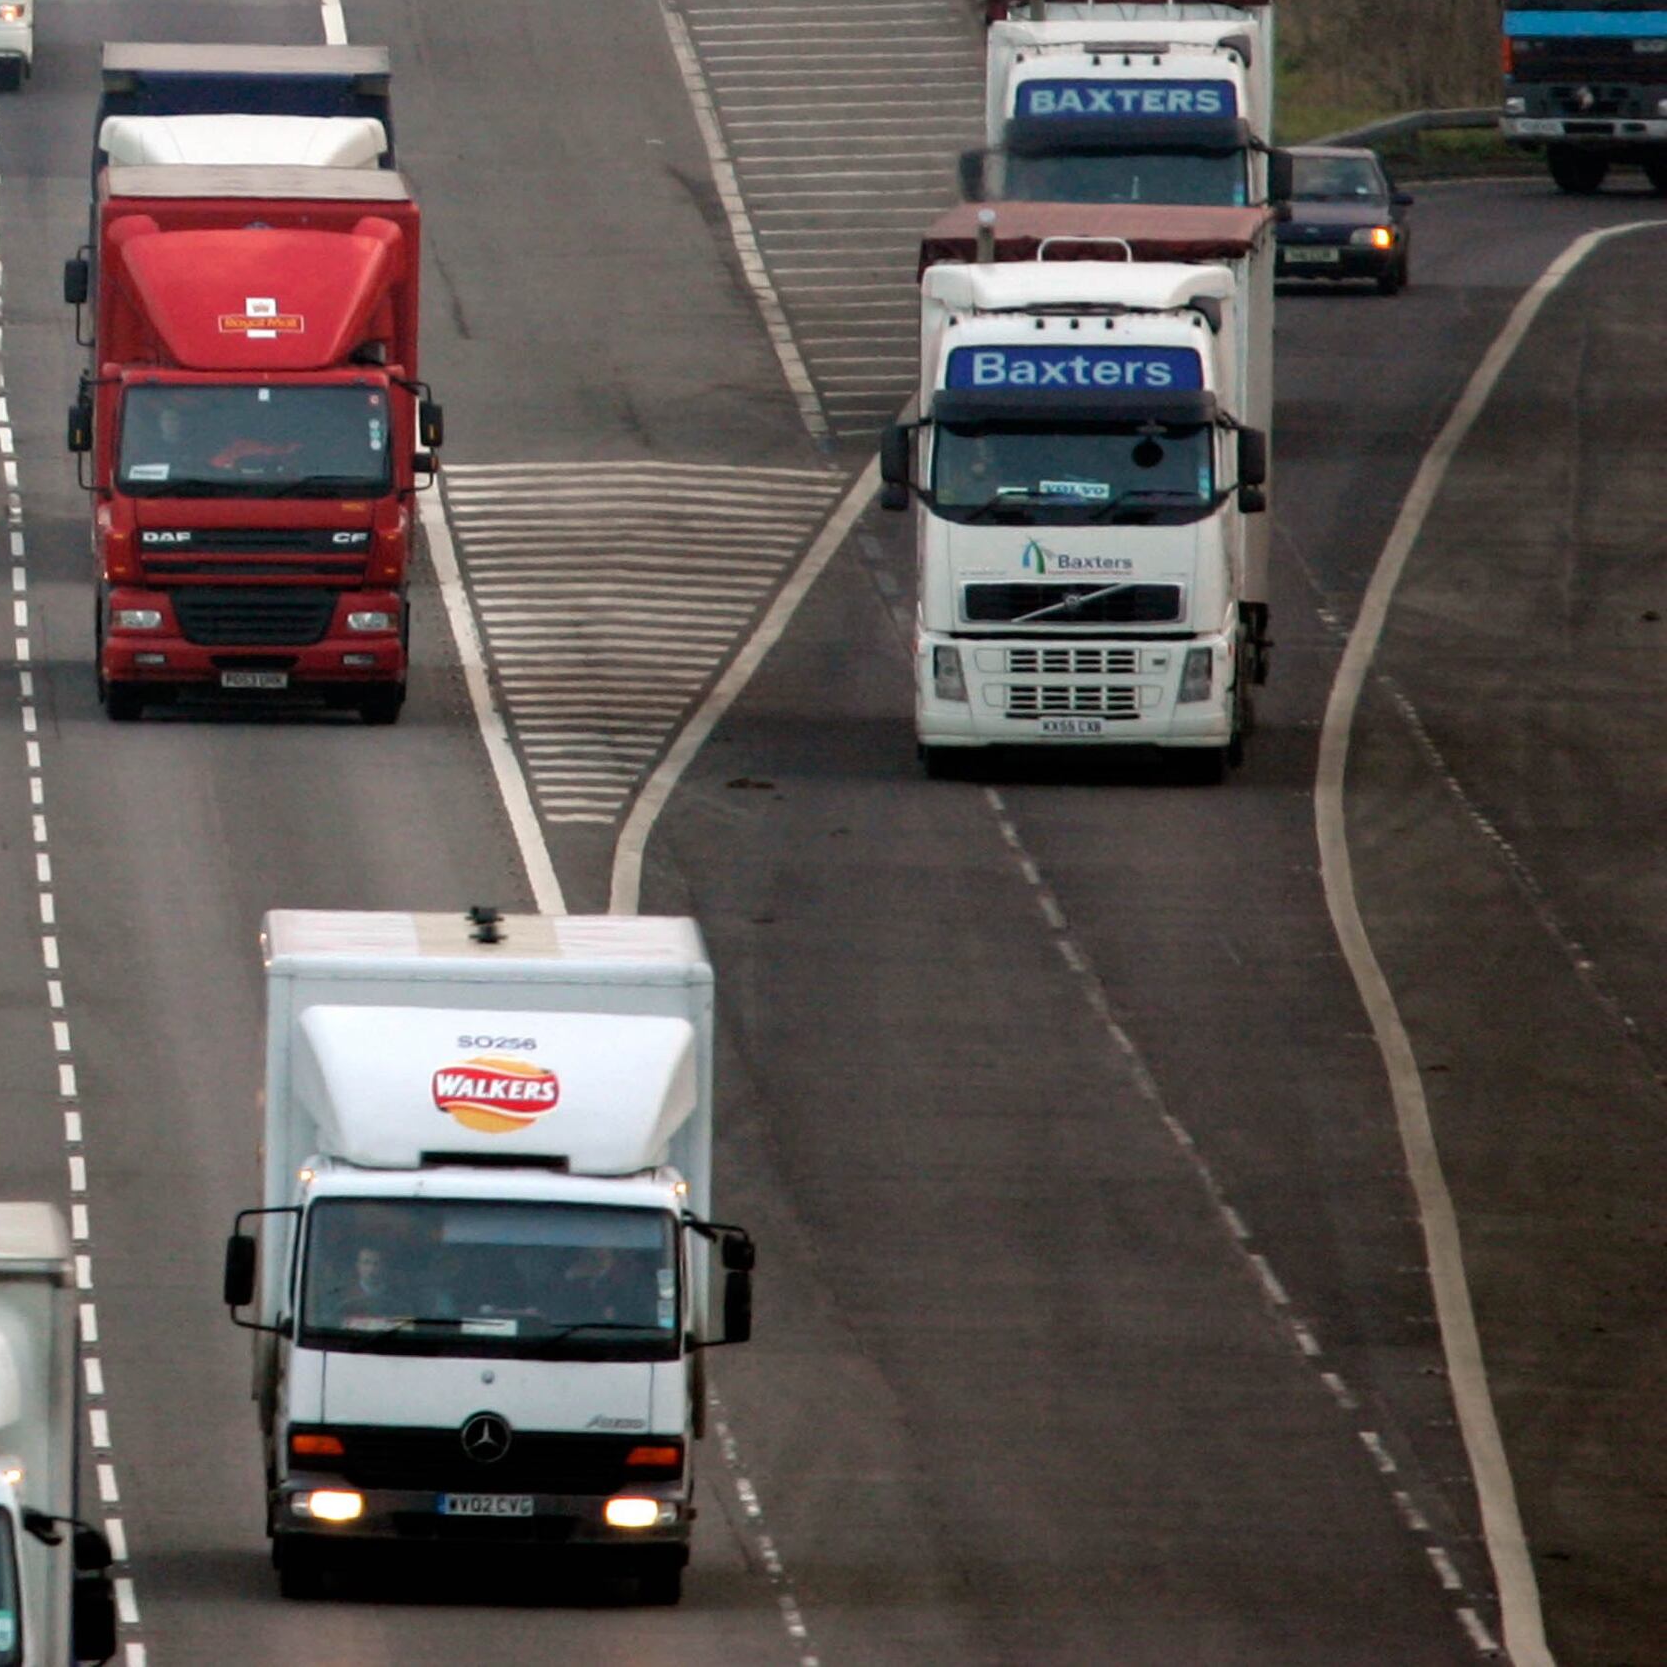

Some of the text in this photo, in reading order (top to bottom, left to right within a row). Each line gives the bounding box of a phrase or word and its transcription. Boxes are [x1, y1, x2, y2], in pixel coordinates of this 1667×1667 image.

[1028, 89, 1223, 114] BAXTERS
[972, 351, 1173, 385] Baxters
[142, 531, 368, 543] DAF CF
[1058, 554, 1133, 570] Baxters
[435, 1072, 556, 1101] WALKERS
